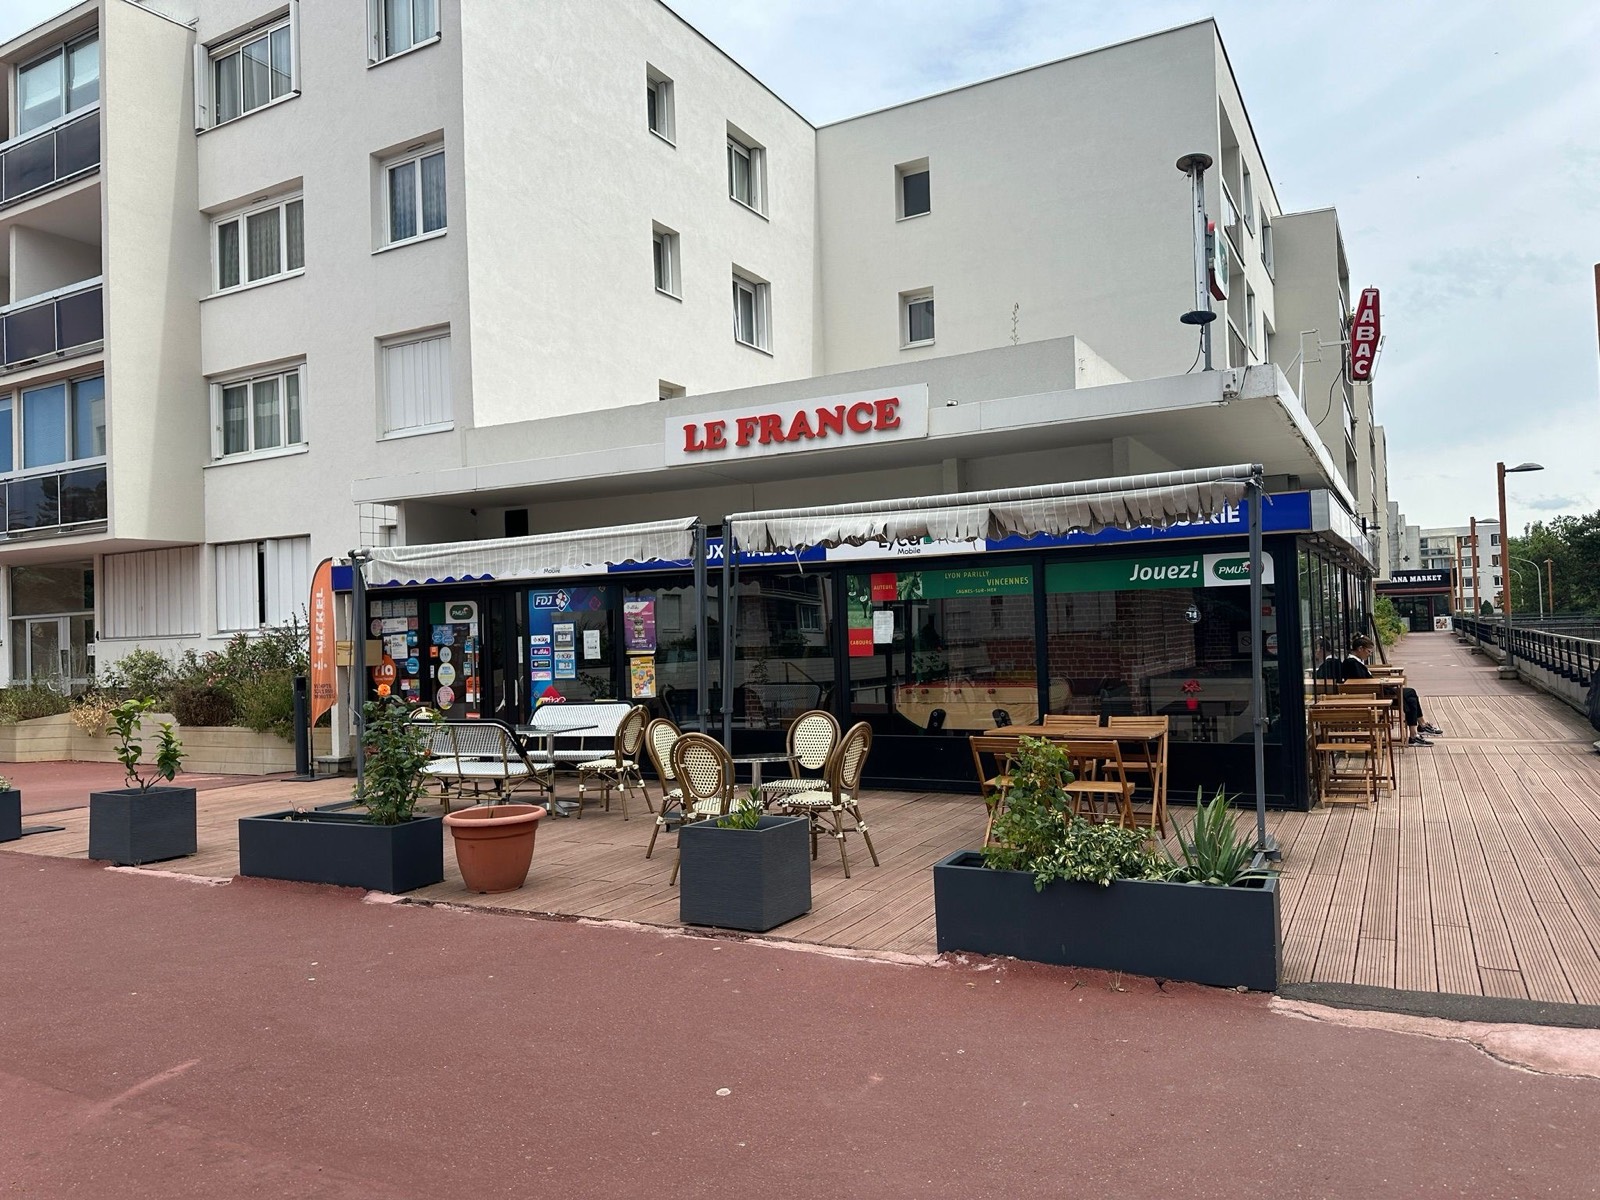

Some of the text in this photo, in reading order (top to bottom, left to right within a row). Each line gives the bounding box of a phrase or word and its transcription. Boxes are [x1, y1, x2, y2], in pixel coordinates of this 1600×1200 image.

[1354, 291, 1377, 375] TABAC
[683, 397, 900, 452] LE FRANCE
[963, 570, 990, 578] PARILLY
[1129, 560, 1199, 581] Jouez!
[1218, 565, 1242, 575] PMU
[986, 576, 1029, 586] VINCENNES
[1409, 574, 1442, 583] MARKET
[535, 595, 553, 606] FDJ
[850, 639, 873, 647] CABOURG
